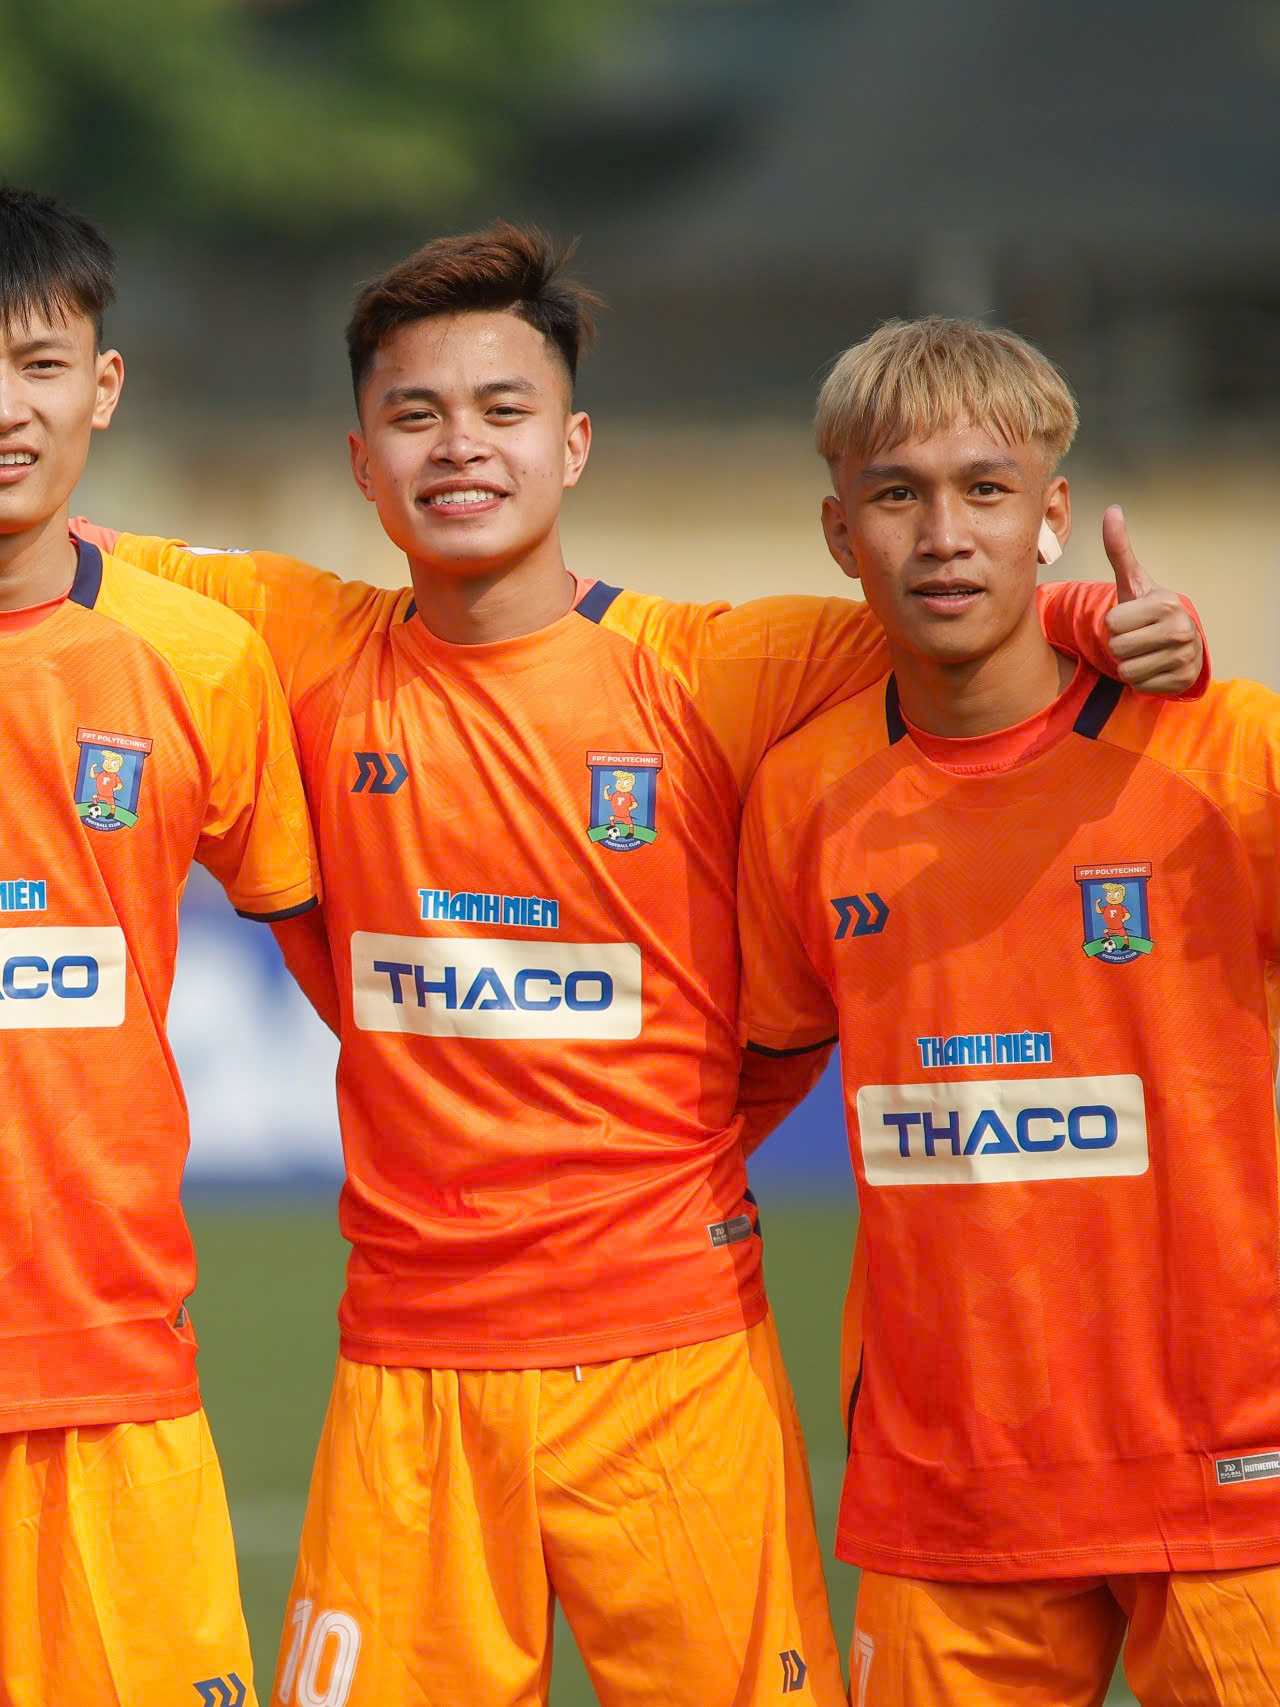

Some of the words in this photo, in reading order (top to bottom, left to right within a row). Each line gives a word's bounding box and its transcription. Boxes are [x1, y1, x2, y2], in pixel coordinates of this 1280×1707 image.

[97, 735, 147, 748] POLYTECHNIC
[1096, 866, 1147, 875] POLYTECHNIC
[418, 888, 501, 924] THANH
[502, 894, 559, 928] NIÊN
[373, 960, 613, 1011] THACO
[917, 1033, 994, 1068] THANH
[995, 1029, 1053, 1064] NIÊN
[882, 1105, 1118, 1158] THACO
[279, 1597, 361, 1707] 10
